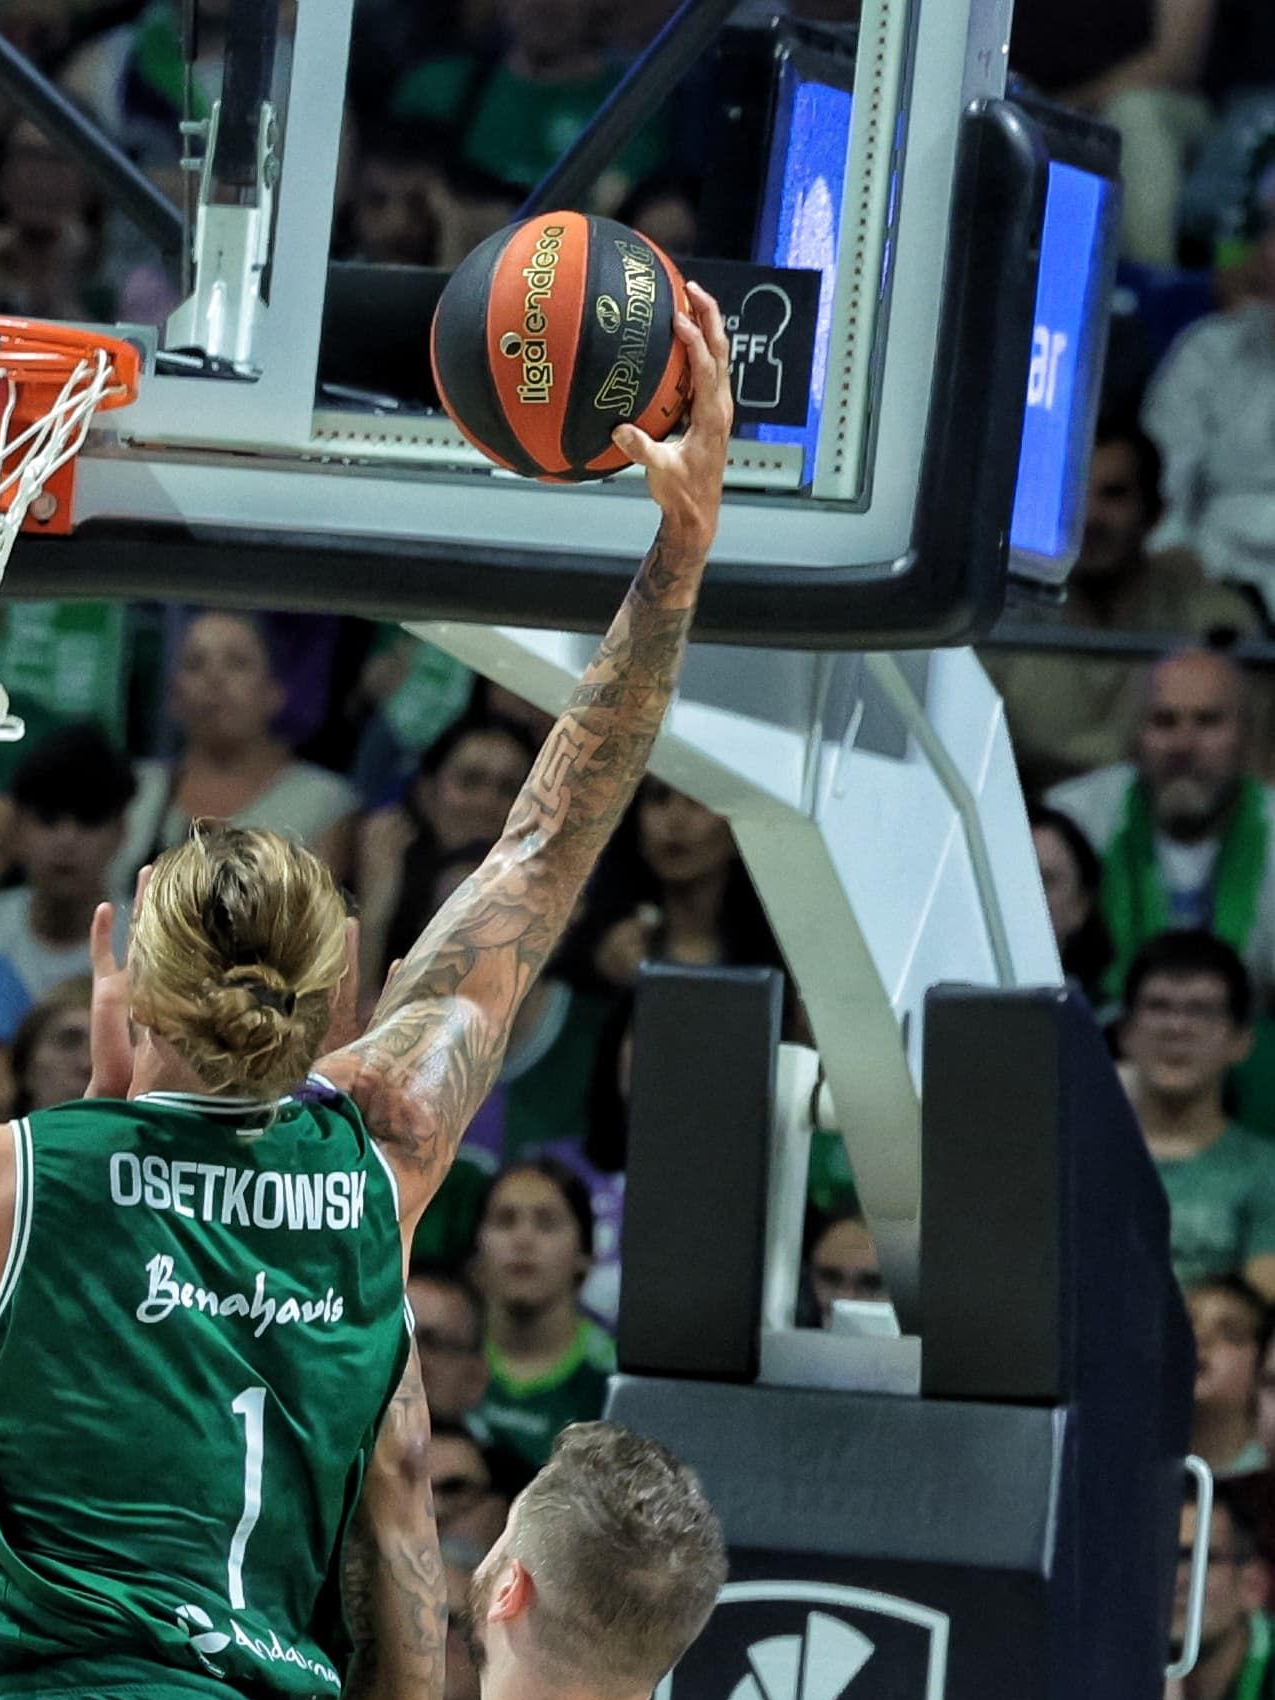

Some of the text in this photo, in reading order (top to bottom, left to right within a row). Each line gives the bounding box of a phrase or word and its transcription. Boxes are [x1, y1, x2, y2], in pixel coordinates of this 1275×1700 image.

[517, 225, 566, 404] liga endesa
[594, 240, 656, 417] SPALDING
[109, 1151, 367, 1231] OSETKOWSK
[227, 1386, 267, 1610] 1
